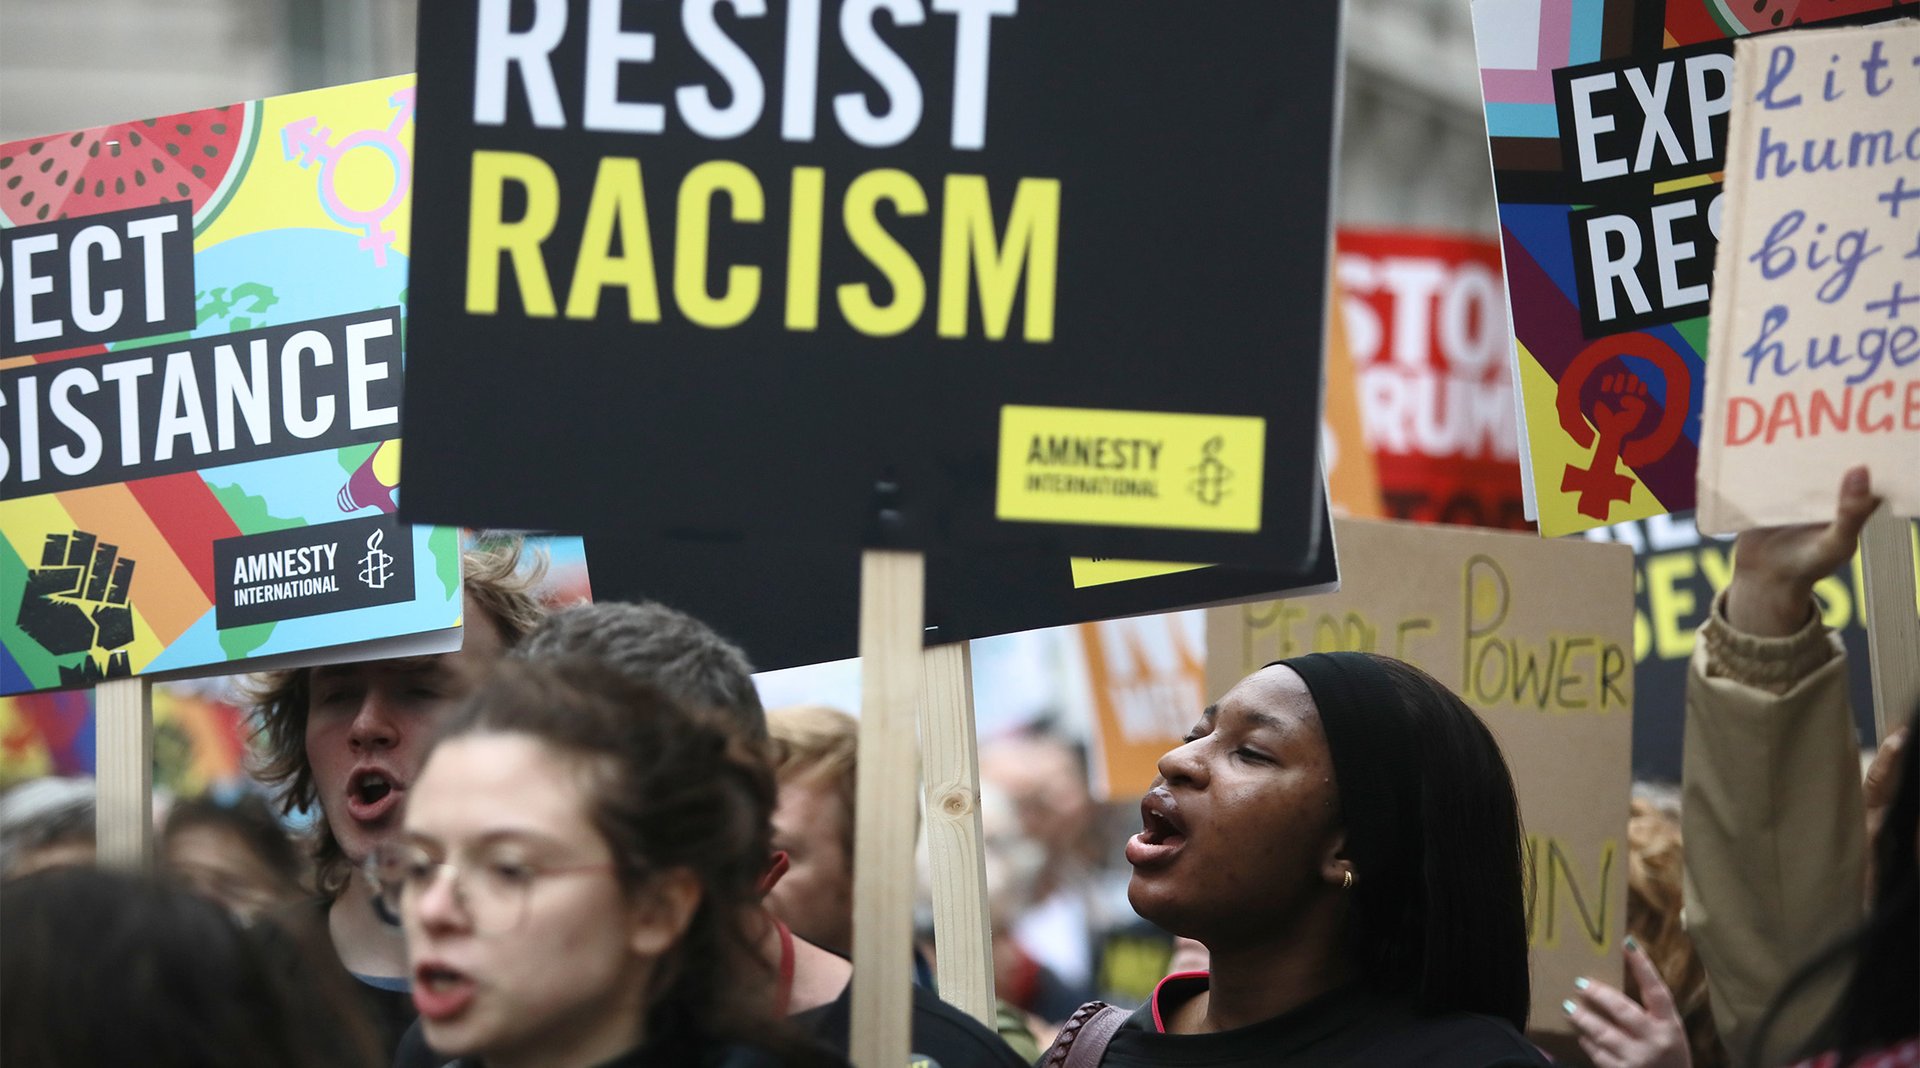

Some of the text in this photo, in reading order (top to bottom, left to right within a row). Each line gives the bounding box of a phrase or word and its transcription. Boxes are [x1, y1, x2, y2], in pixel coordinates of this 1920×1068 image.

[473, 0, 1018, 149] RESIST
[1756, 40, 1920, 110] lit
[0, 214, 178, 342] ECT
[465, 150, 1061, 342] RACISM
[1749, 209, 1883, 304] big
[1337, 252, 1512, 372] STO
[1742, 304, 1920, 384] huge
[0, 318, 399, 483] ISTANCE
[1026, 434, 1164, 471] AMNESTY
[1026, 473, 1160, 499] INTERNATIONAL
[233, 542, 338, 585] AMNESTY
[234, 575, 340, 607] INTERNATIONAL
[1464, 557, 1628, 709] POWER
